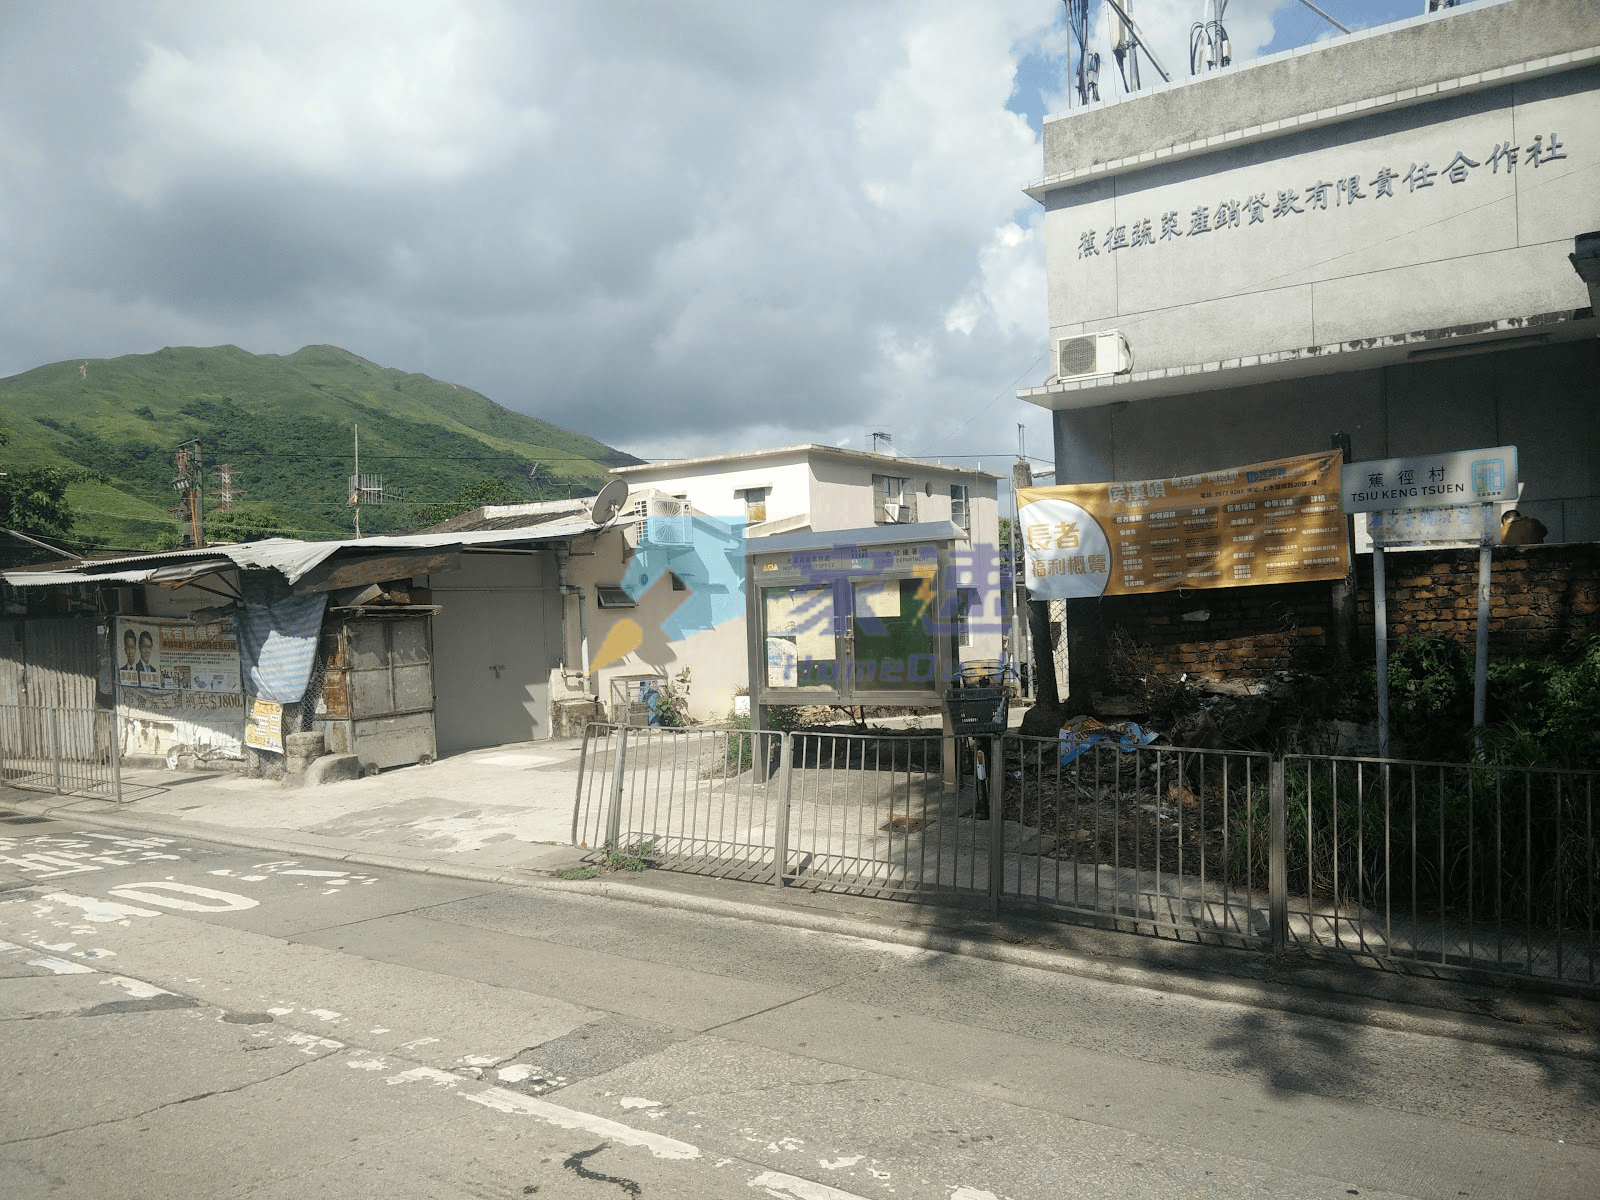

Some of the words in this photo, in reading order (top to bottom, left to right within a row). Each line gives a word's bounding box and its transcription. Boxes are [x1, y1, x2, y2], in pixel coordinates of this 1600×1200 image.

[1368, 466, 1445, 488] 蕉徑村
[1351, 490, 1379, 502] TSIU
[1382, 487, 1418, 499] KENG
[1421, 483, 1464, 497] TSUEN
[1027, 521, 1080, 551] 長者
[1031, 553, 1107, 578] 福利概覽
